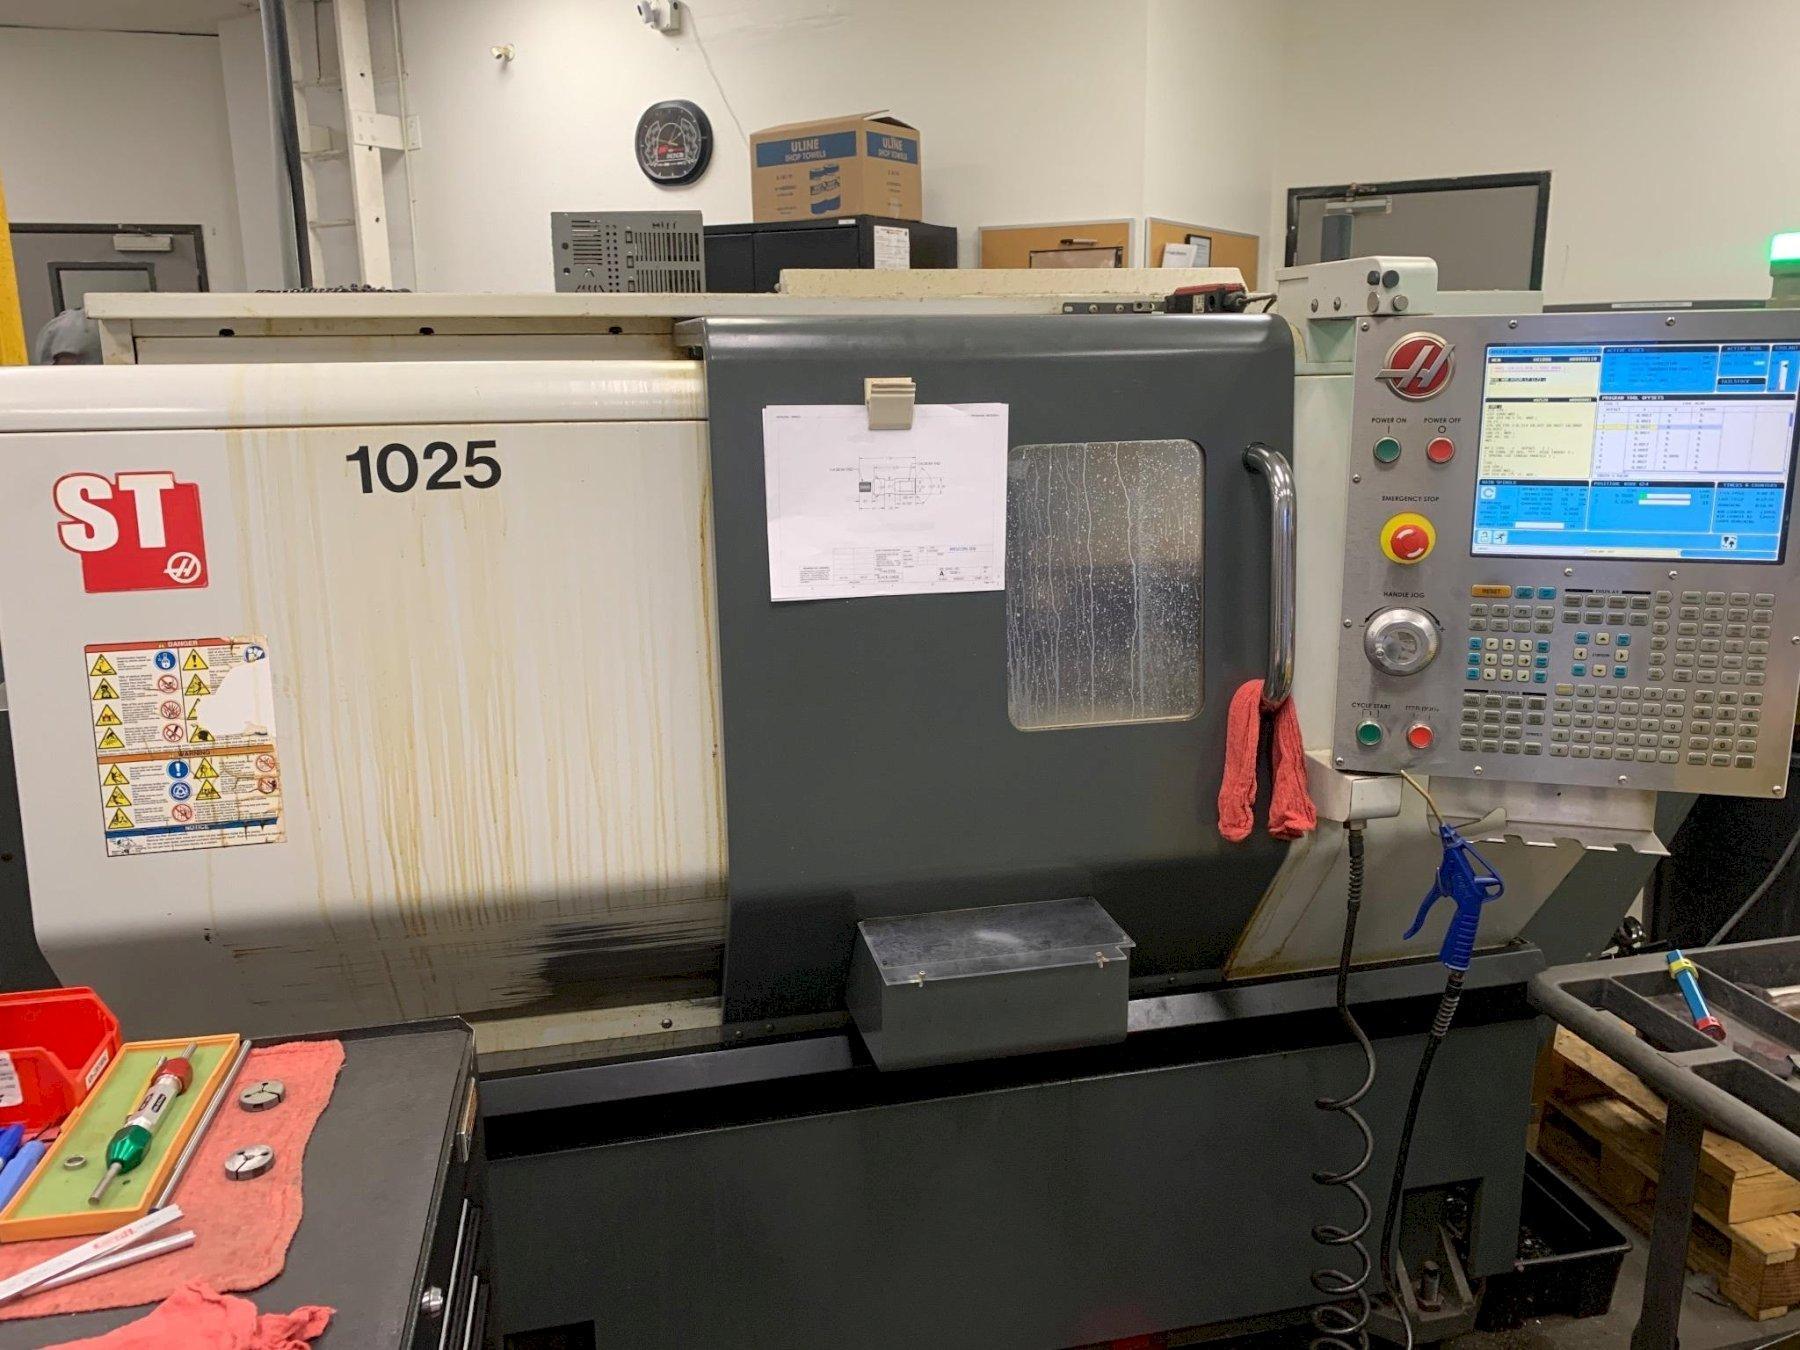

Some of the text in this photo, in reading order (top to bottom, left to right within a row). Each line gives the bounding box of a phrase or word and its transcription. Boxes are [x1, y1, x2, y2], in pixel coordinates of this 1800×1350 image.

[791, 139, 819, 153] ULINE
[882, 138, 903, 151] ULINE
[346, 440, 502, 494] 1025
[55, 473, 175, 553] ST
[179, 749, 211, 757] WARNING
